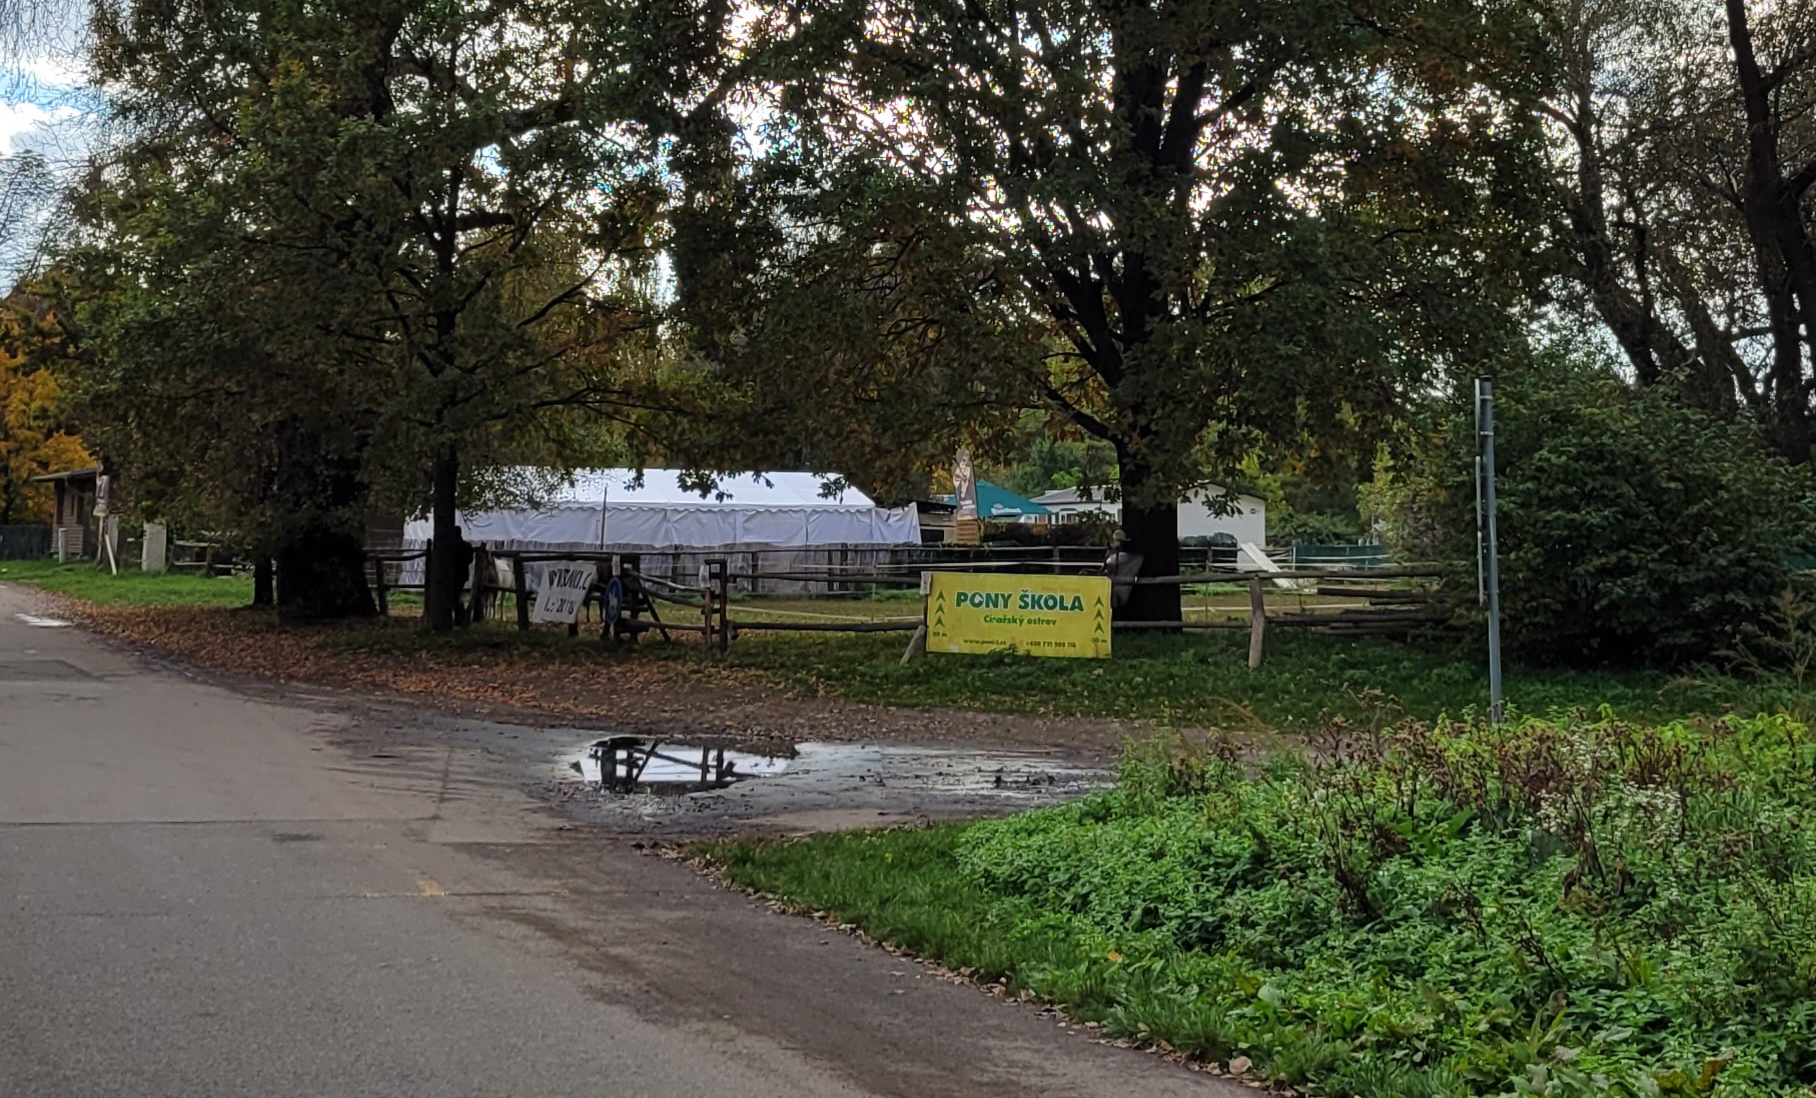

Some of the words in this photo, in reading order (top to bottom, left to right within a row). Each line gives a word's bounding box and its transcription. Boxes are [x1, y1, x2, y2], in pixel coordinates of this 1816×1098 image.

[956, 591, 1013, 609] PONY
[1018, 589, 1084, 612] ŠKOLA
[1026, 617, 1057, 626] ostrov
